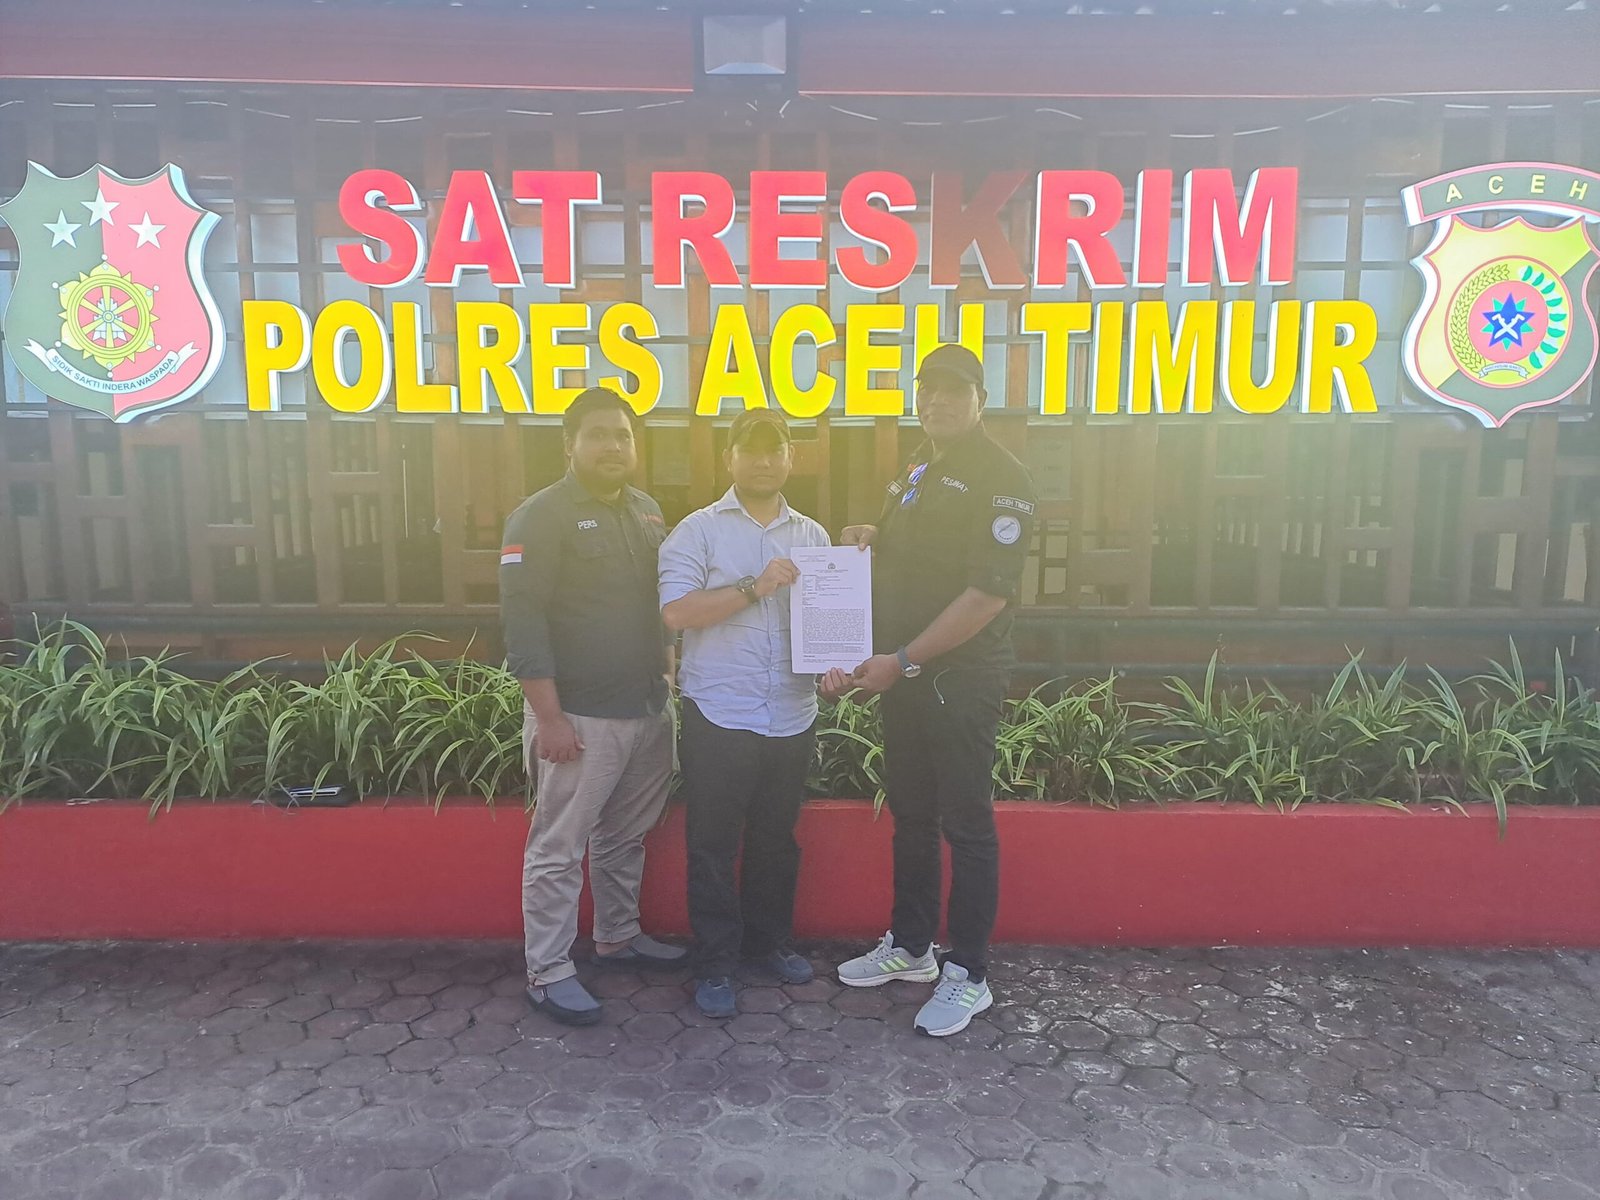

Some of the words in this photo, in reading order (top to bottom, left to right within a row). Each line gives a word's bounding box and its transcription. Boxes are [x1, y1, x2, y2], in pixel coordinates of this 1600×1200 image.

[1446, 174, 1589, 203] ACEH
[337, 169, 602, 288] SAT
[651, 166, 1299, 290] RESKRIM
[52, 355, 72, 375] SIDIK
[73, 371, 101, 389] SAKTI
[102, 379, 137, 391] INDERA
[138, 358, 174, 387] WASPADA
[242, 299, 662, 415] POLRES
[1022, 300, 1379, 415] TIMUR
[996, 498, 1014, 507] ACEH
[1014, 500, 1031, 512] TIMUR
